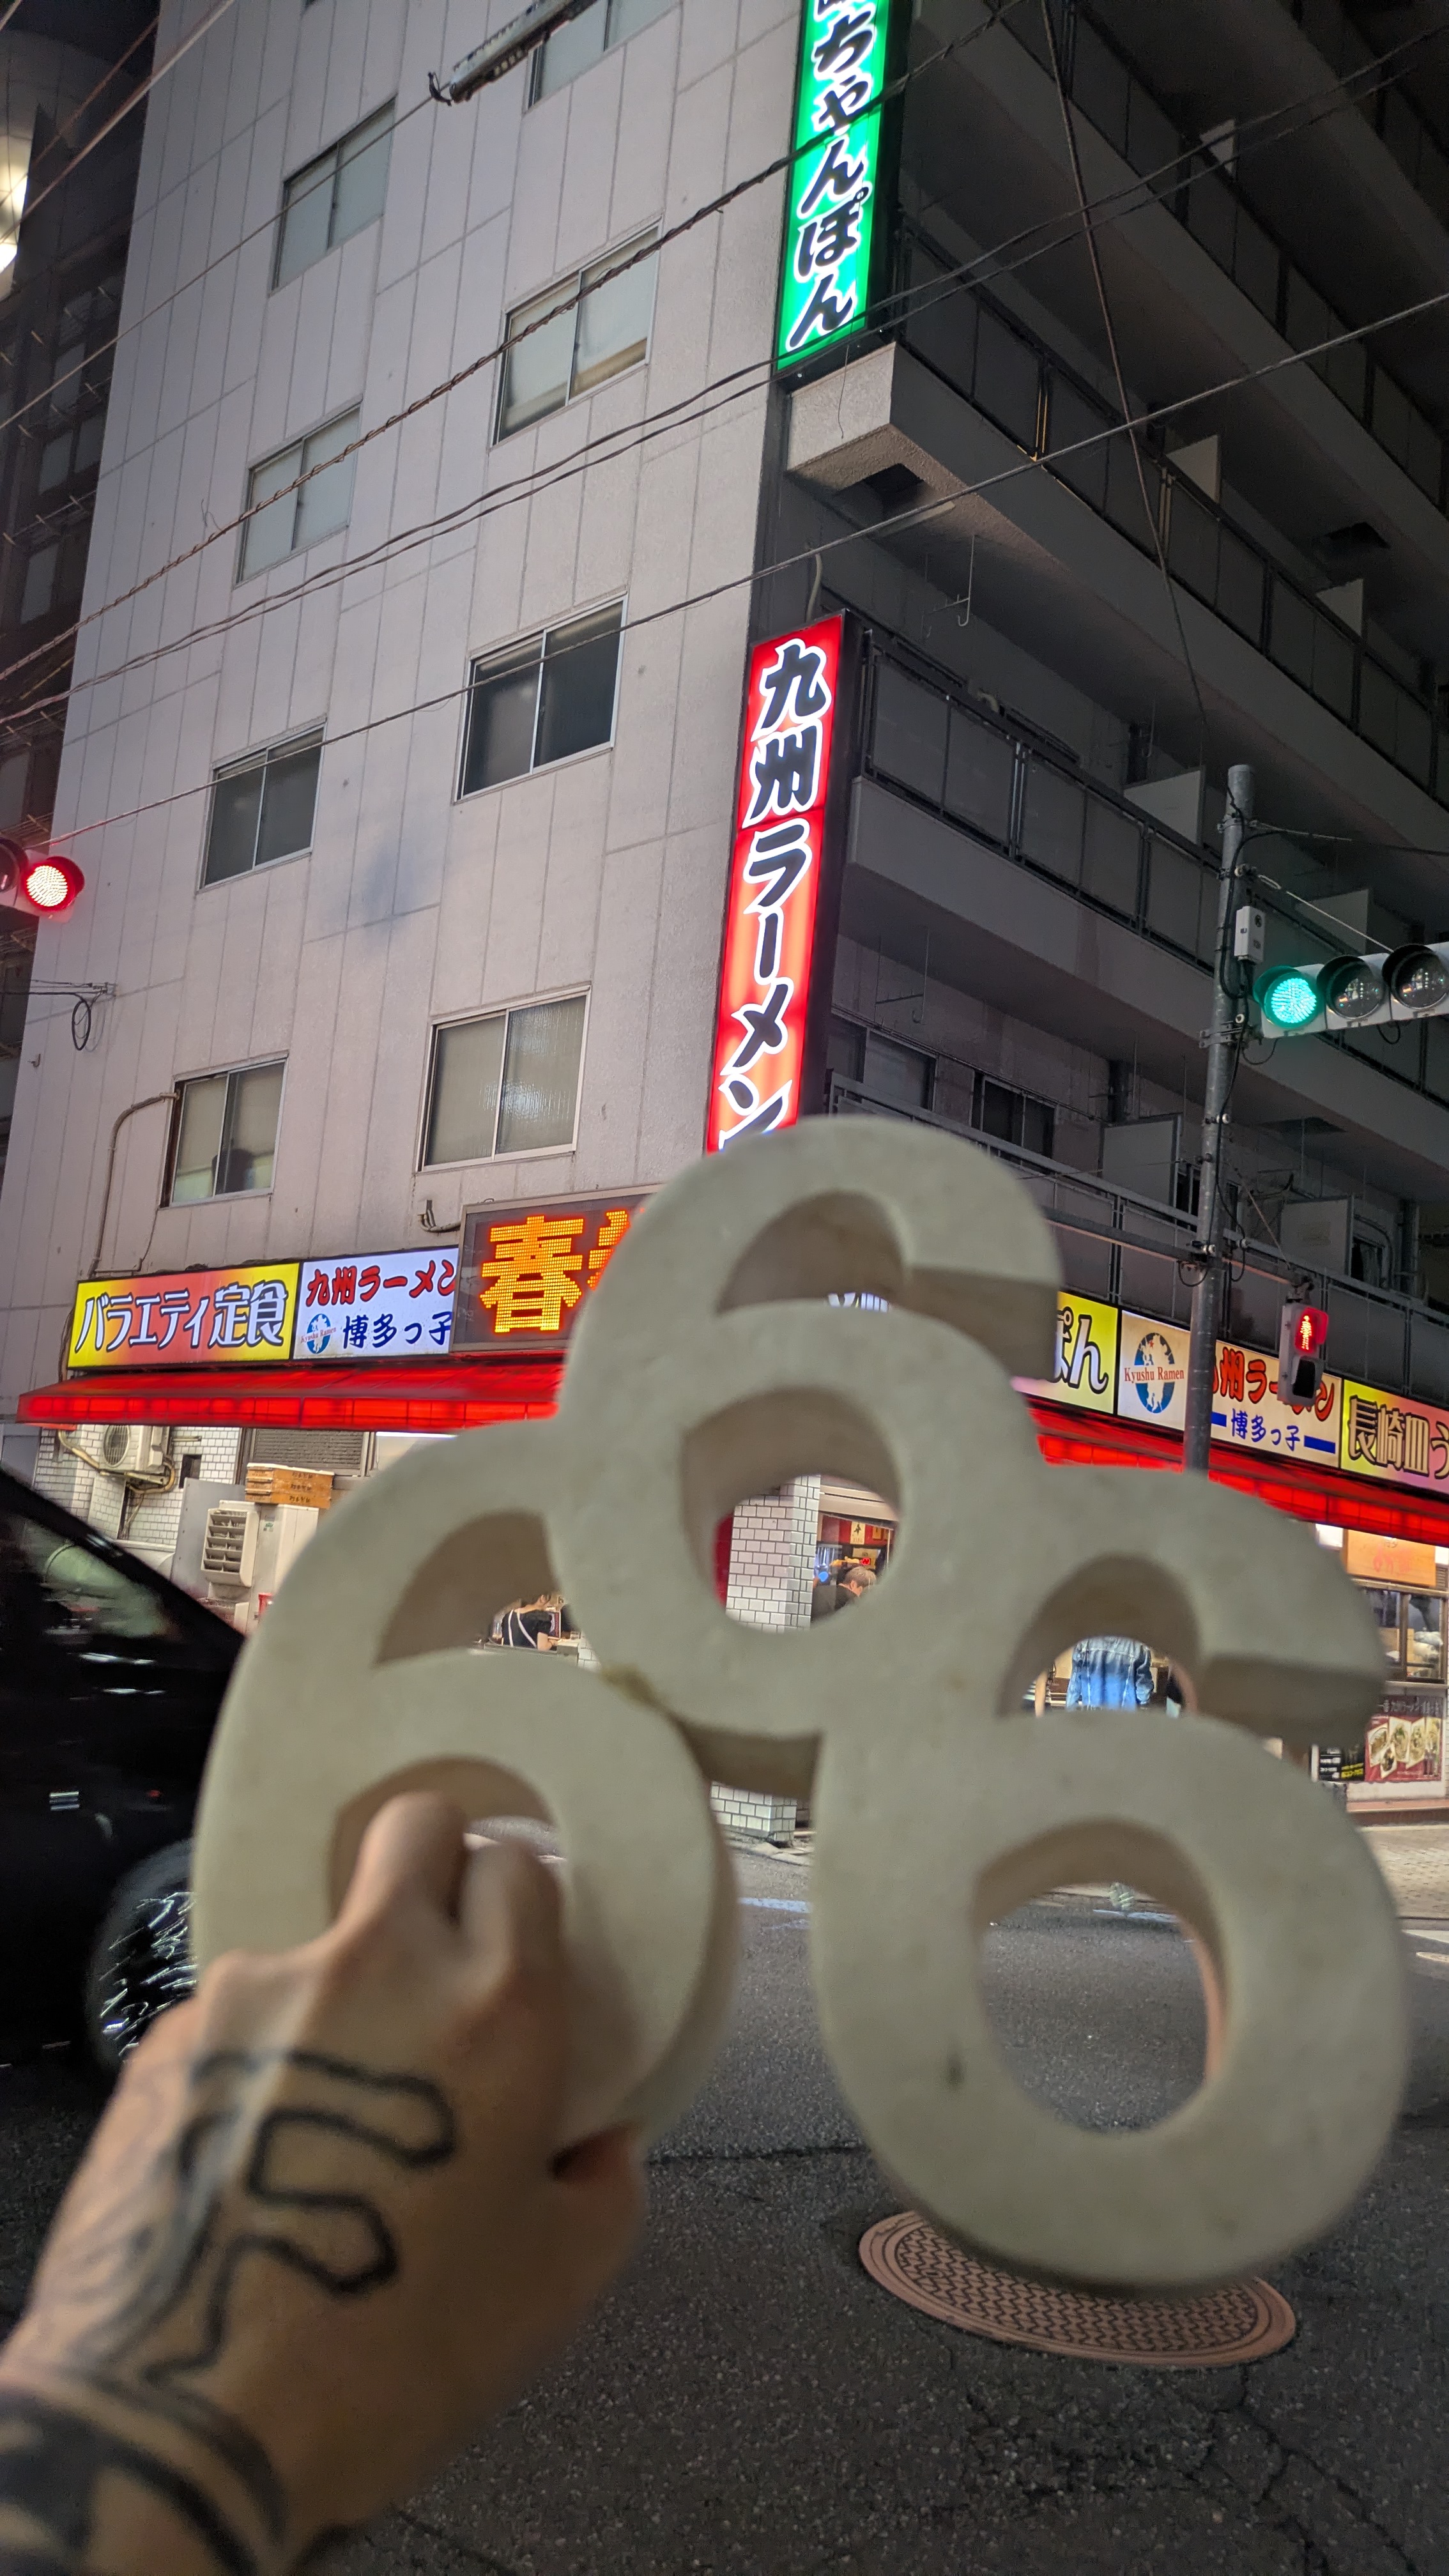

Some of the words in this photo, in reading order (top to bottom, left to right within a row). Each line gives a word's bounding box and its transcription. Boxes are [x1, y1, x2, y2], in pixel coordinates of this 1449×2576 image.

[787, 0, 878, 351] ちゃんぽん
[717, 638, 834, 1151] 九州ラーメン
[305, 1259, 456, 1307] 九州ラーメン
[74, 1279, 289, 1354] バラエティ定食
[342, 1311, 453, 1349] 博多っ子
[1124, 1367, 1154, 1384] Kyushu
[1158, 1367, 1184, 1380] Ramen
[1213, 1346, 1335, 1422] 州ラン
[1231, 1407, 1301, 1452] 博多っ子
